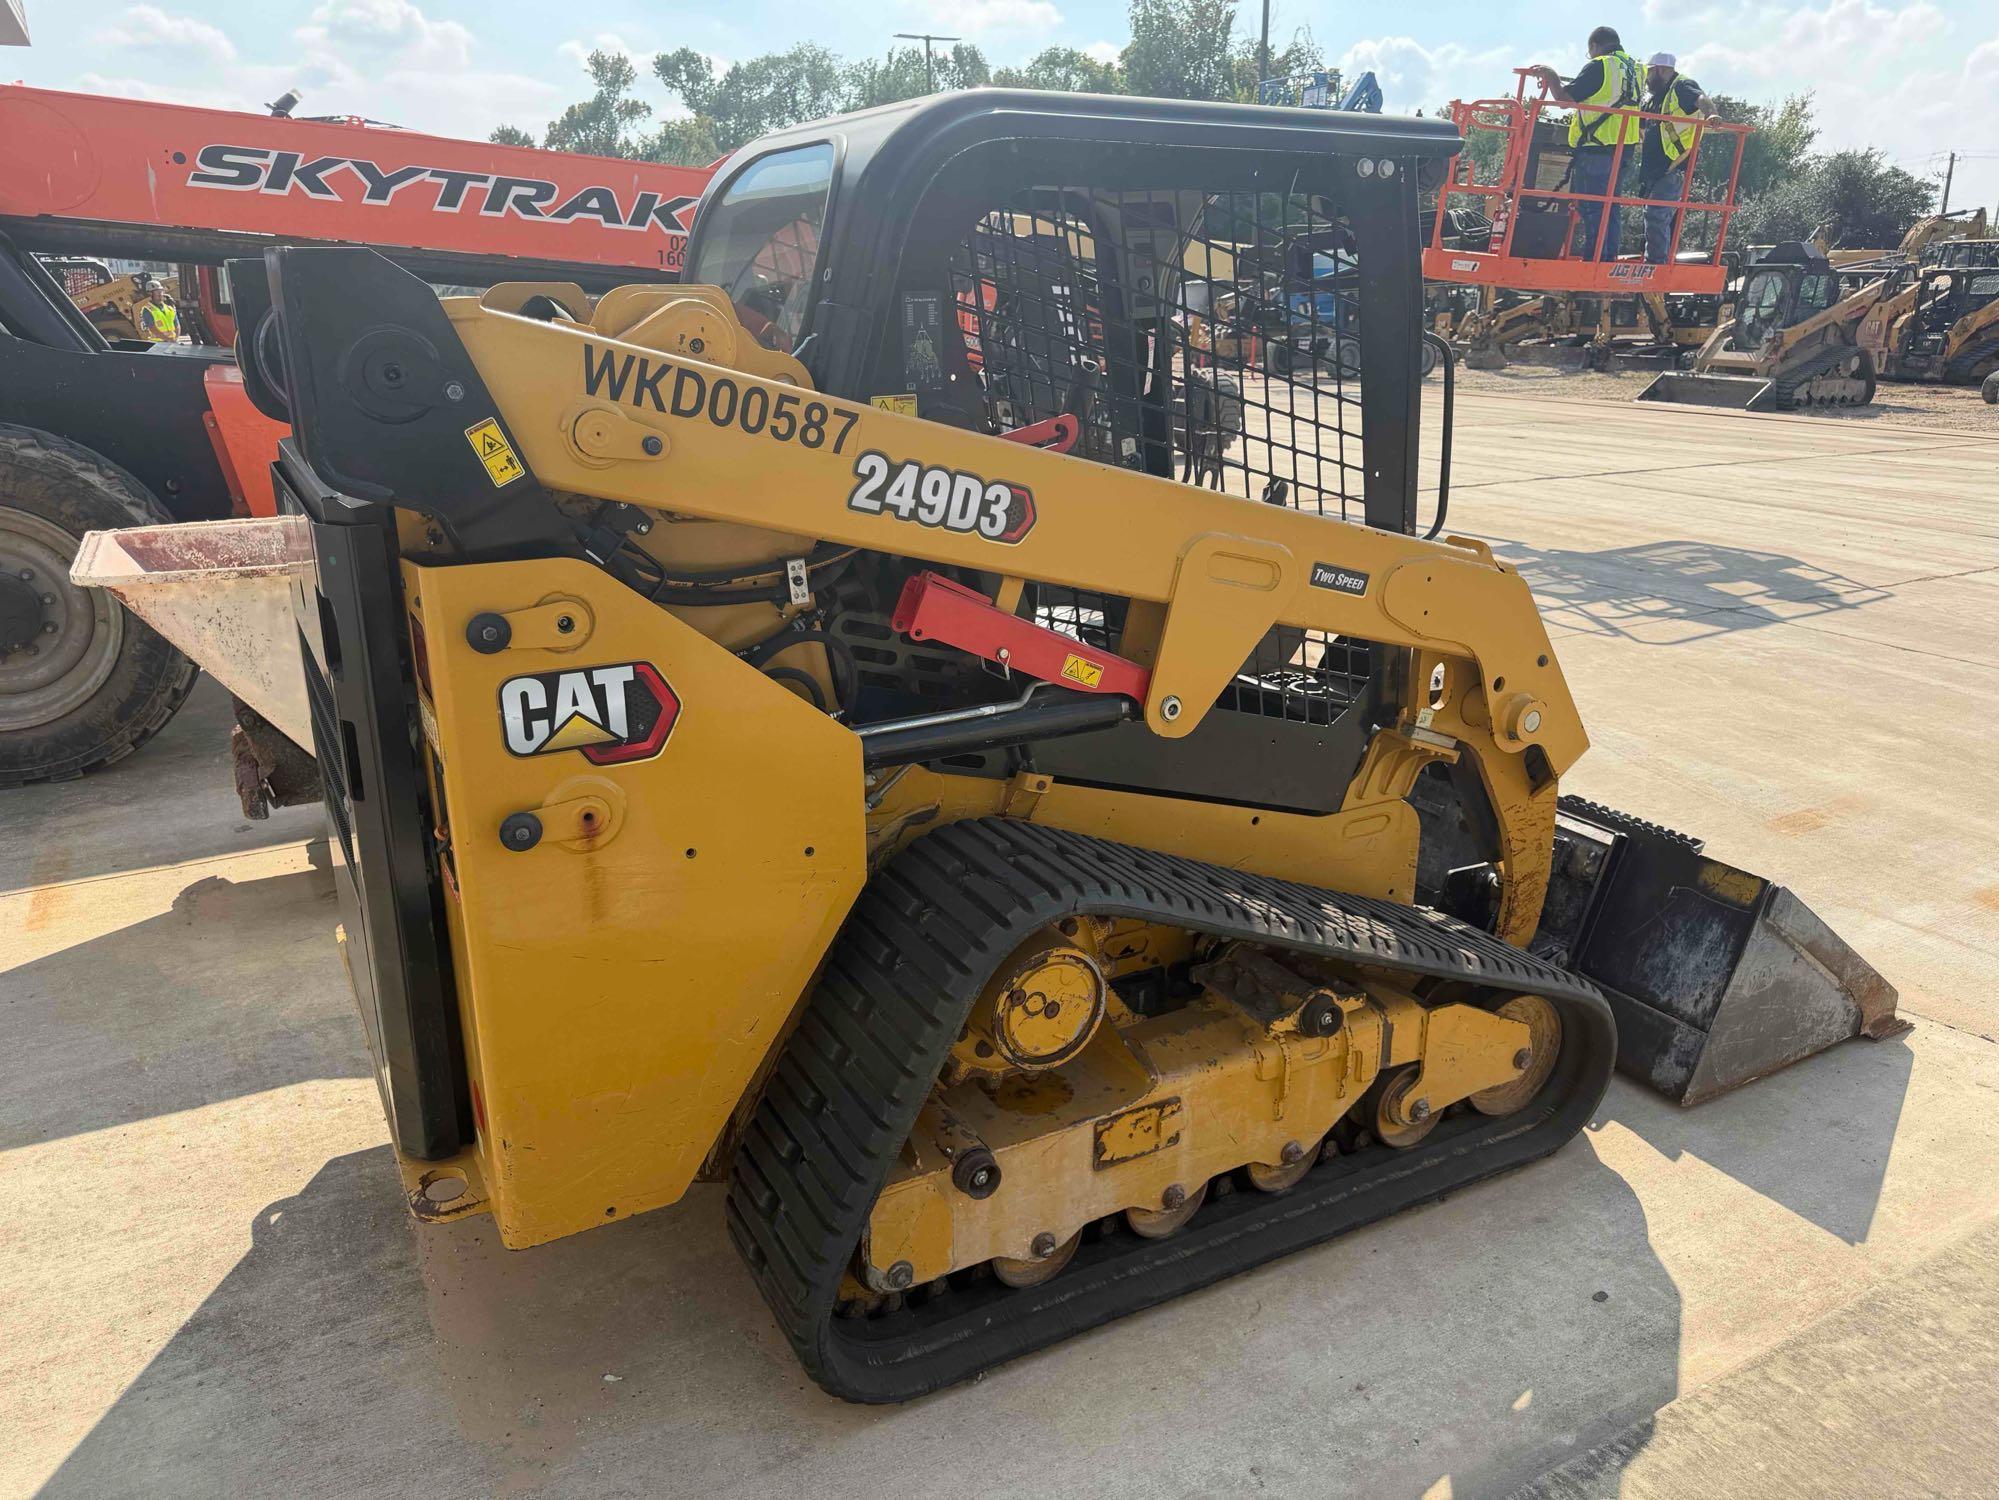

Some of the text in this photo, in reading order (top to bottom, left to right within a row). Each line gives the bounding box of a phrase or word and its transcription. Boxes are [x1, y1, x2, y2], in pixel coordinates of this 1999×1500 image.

[187, 144, 700, 236] SKYTRAK
[1631, 263, 1657, 280] LIFT
[583, 343, 860, 455] WKD00587
[851, 453, 1012, 537] 249D3
[501, 665, 635, 755] CAT
